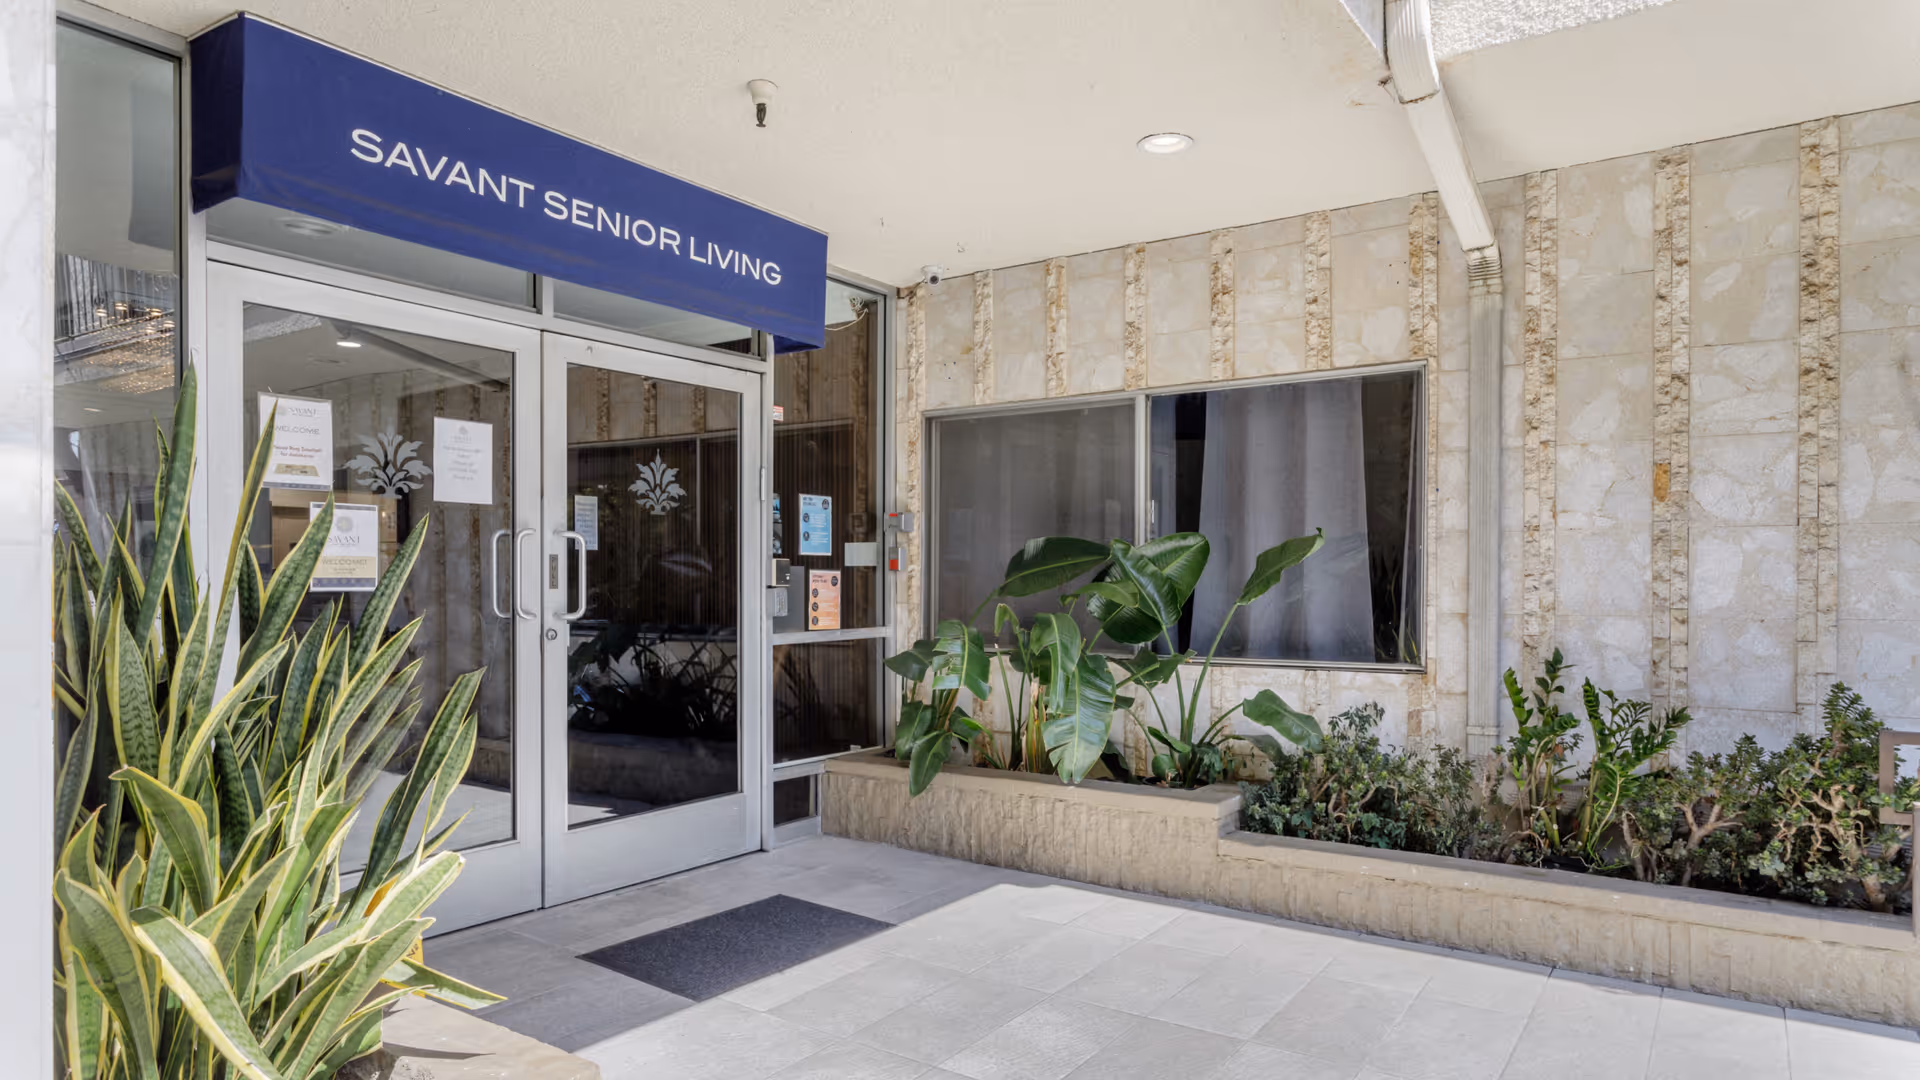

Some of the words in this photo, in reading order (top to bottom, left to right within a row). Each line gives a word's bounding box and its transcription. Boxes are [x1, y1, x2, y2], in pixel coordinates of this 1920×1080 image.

[350, 128, 535, 208] SAVANT
[543, 190, 681, 256] SENIOR
[689, 236, 782, 286] LIVING
